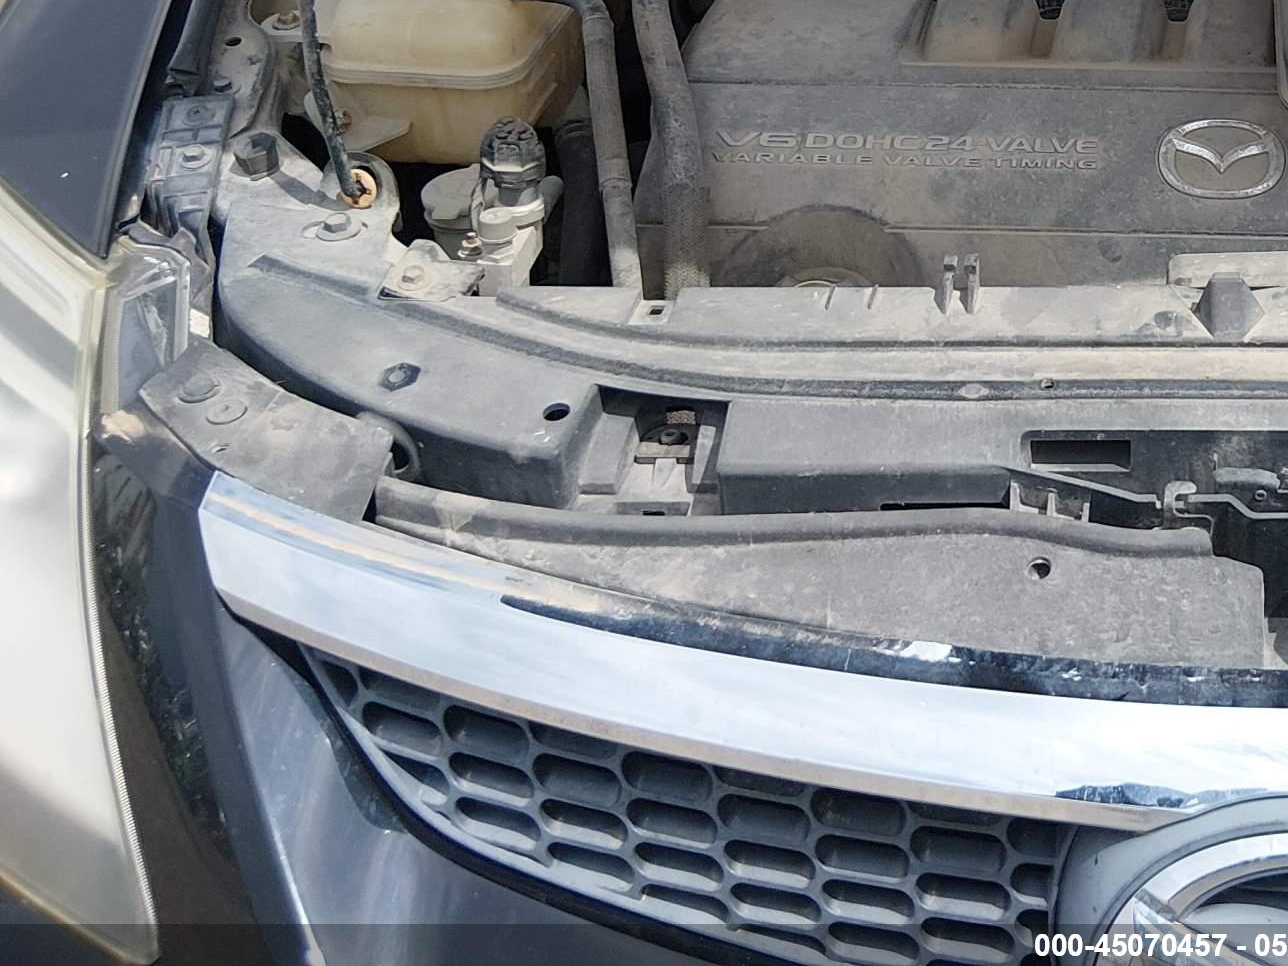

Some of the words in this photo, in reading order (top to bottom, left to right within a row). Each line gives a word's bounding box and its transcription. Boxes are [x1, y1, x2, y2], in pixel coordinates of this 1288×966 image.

[716, 130, 797, 148] V6
[804, 132, 920, 150] DOHC
[712, 152, 873, 165] VARIABLE
[883, 155, 982, 168] VALVE
[989, 157, 1098, 170] TIMING
